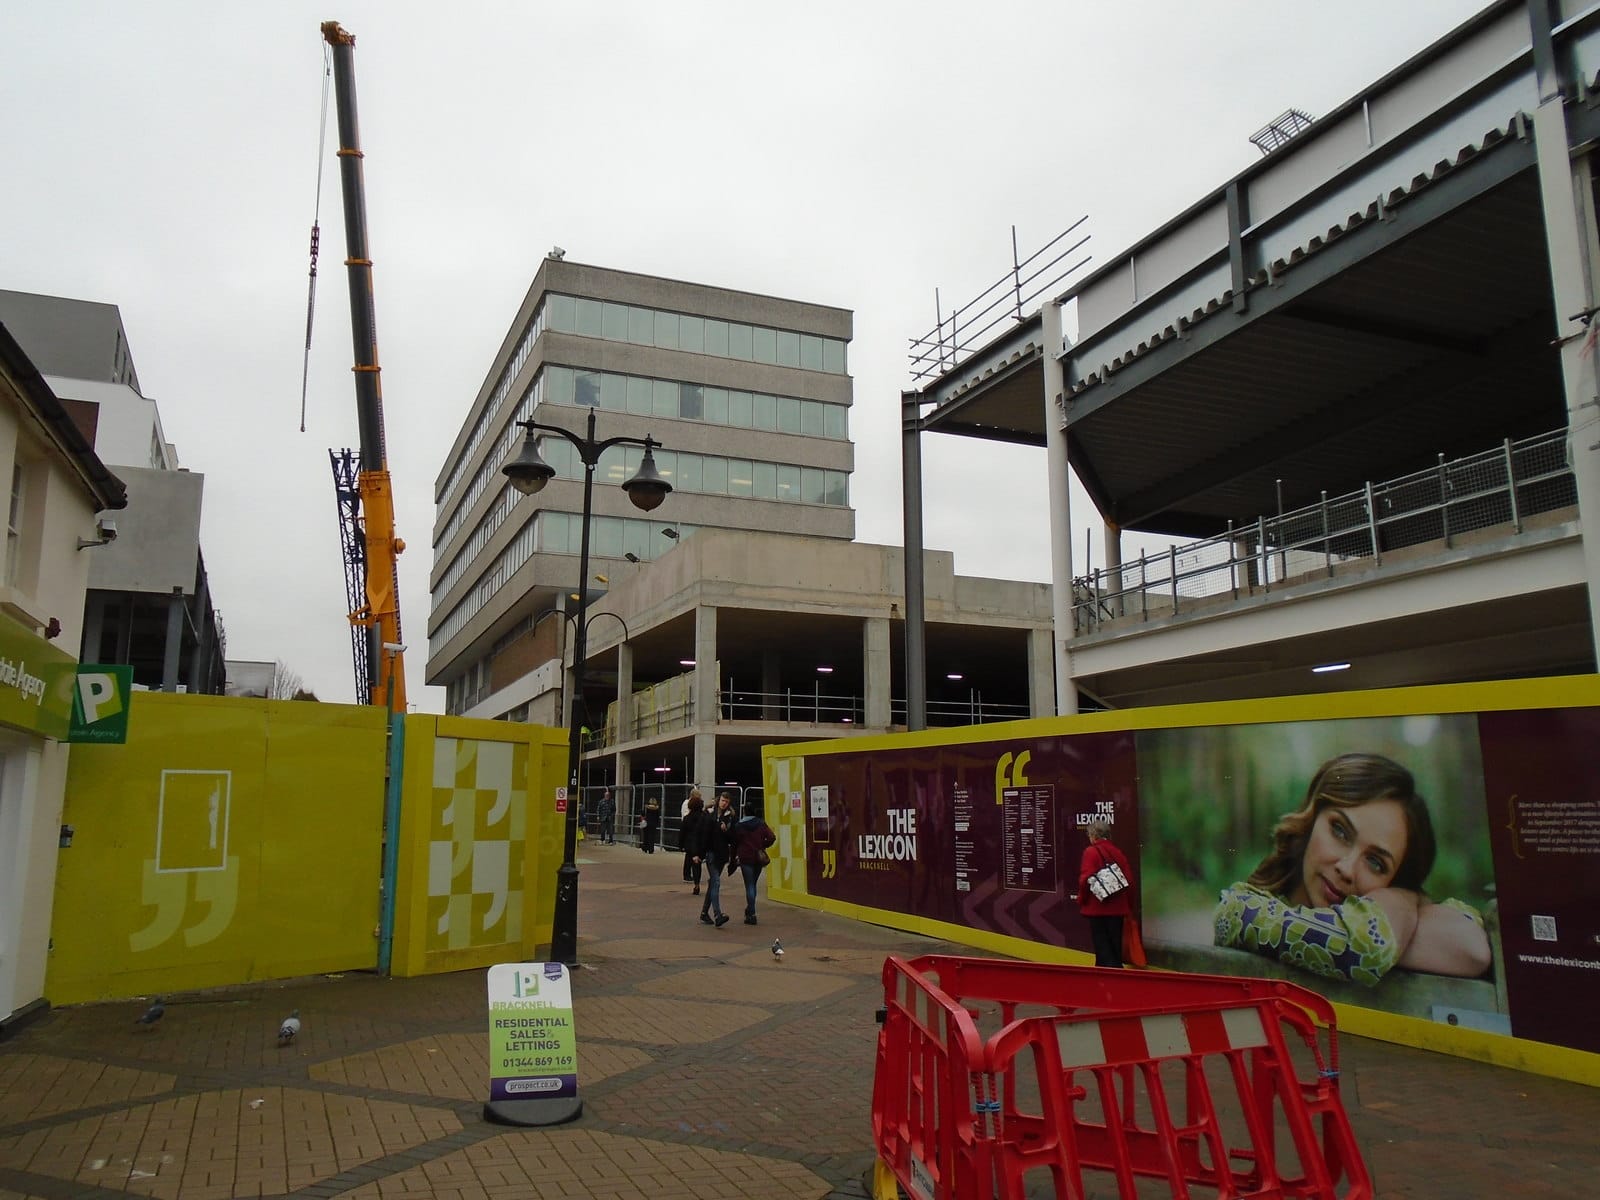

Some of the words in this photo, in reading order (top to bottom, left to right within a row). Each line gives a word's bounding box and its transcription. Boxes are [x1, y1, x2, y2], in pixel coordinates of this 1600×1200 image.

[16, 661, 46, 706] Agency
[1095, 801, 1114, 813] THE
[886, 808, 917, 834] THE
[1076, 813, 1115, 825] LEXICON
[858, 834, 917, 861] LEXICON
[859, 861, 890, 871] BRACKNELL
[492, 1000, 556, 1010] BRACKNELL
[495, 1017, 568, 1029] RESIDENTIAL
[510, 1029, 546, 1040] SALES
[505, 1040, 561, 1052] LETTINGS
[503, 1057, 533, 1068] 01344
[535, 1057, 553, 1067] 869
[556, 1055, 573, 1066] 169
[509, 1078, 560, 1092] prospect.co.uk
